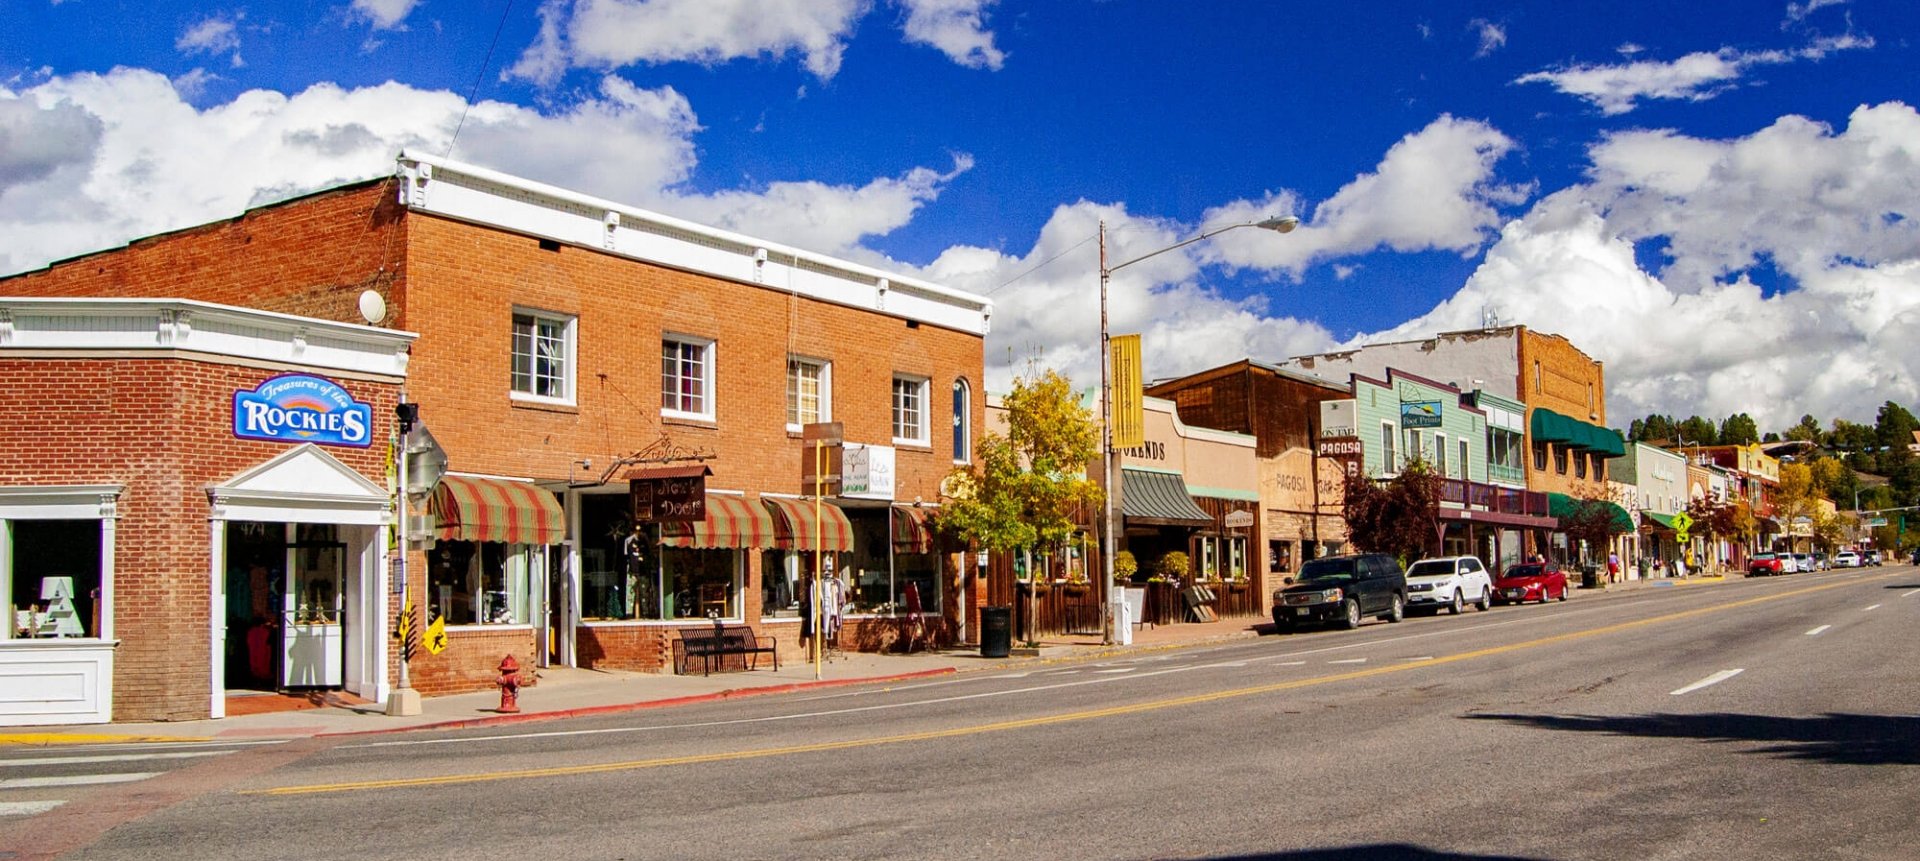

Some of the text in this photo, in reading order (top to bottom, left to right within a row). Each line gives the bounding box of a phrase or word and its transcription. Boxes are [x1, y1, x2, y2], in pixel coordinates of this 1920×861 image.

[262, 380, 349, 408] Treasures of the
[242, 399, 366, 442] ROCKIES
[1322, 428, 1334, 437] ON
[1335, 427, 1355, 437] TAP
[1112, 441, 1166, 460] KENDS
[1320, 441, 1361, 454] PAGOSA
[657, 479, 697, 495] Next
[1276, 473, 1307, 492] PAGOSA
[660, 500, 701, 517] Door
